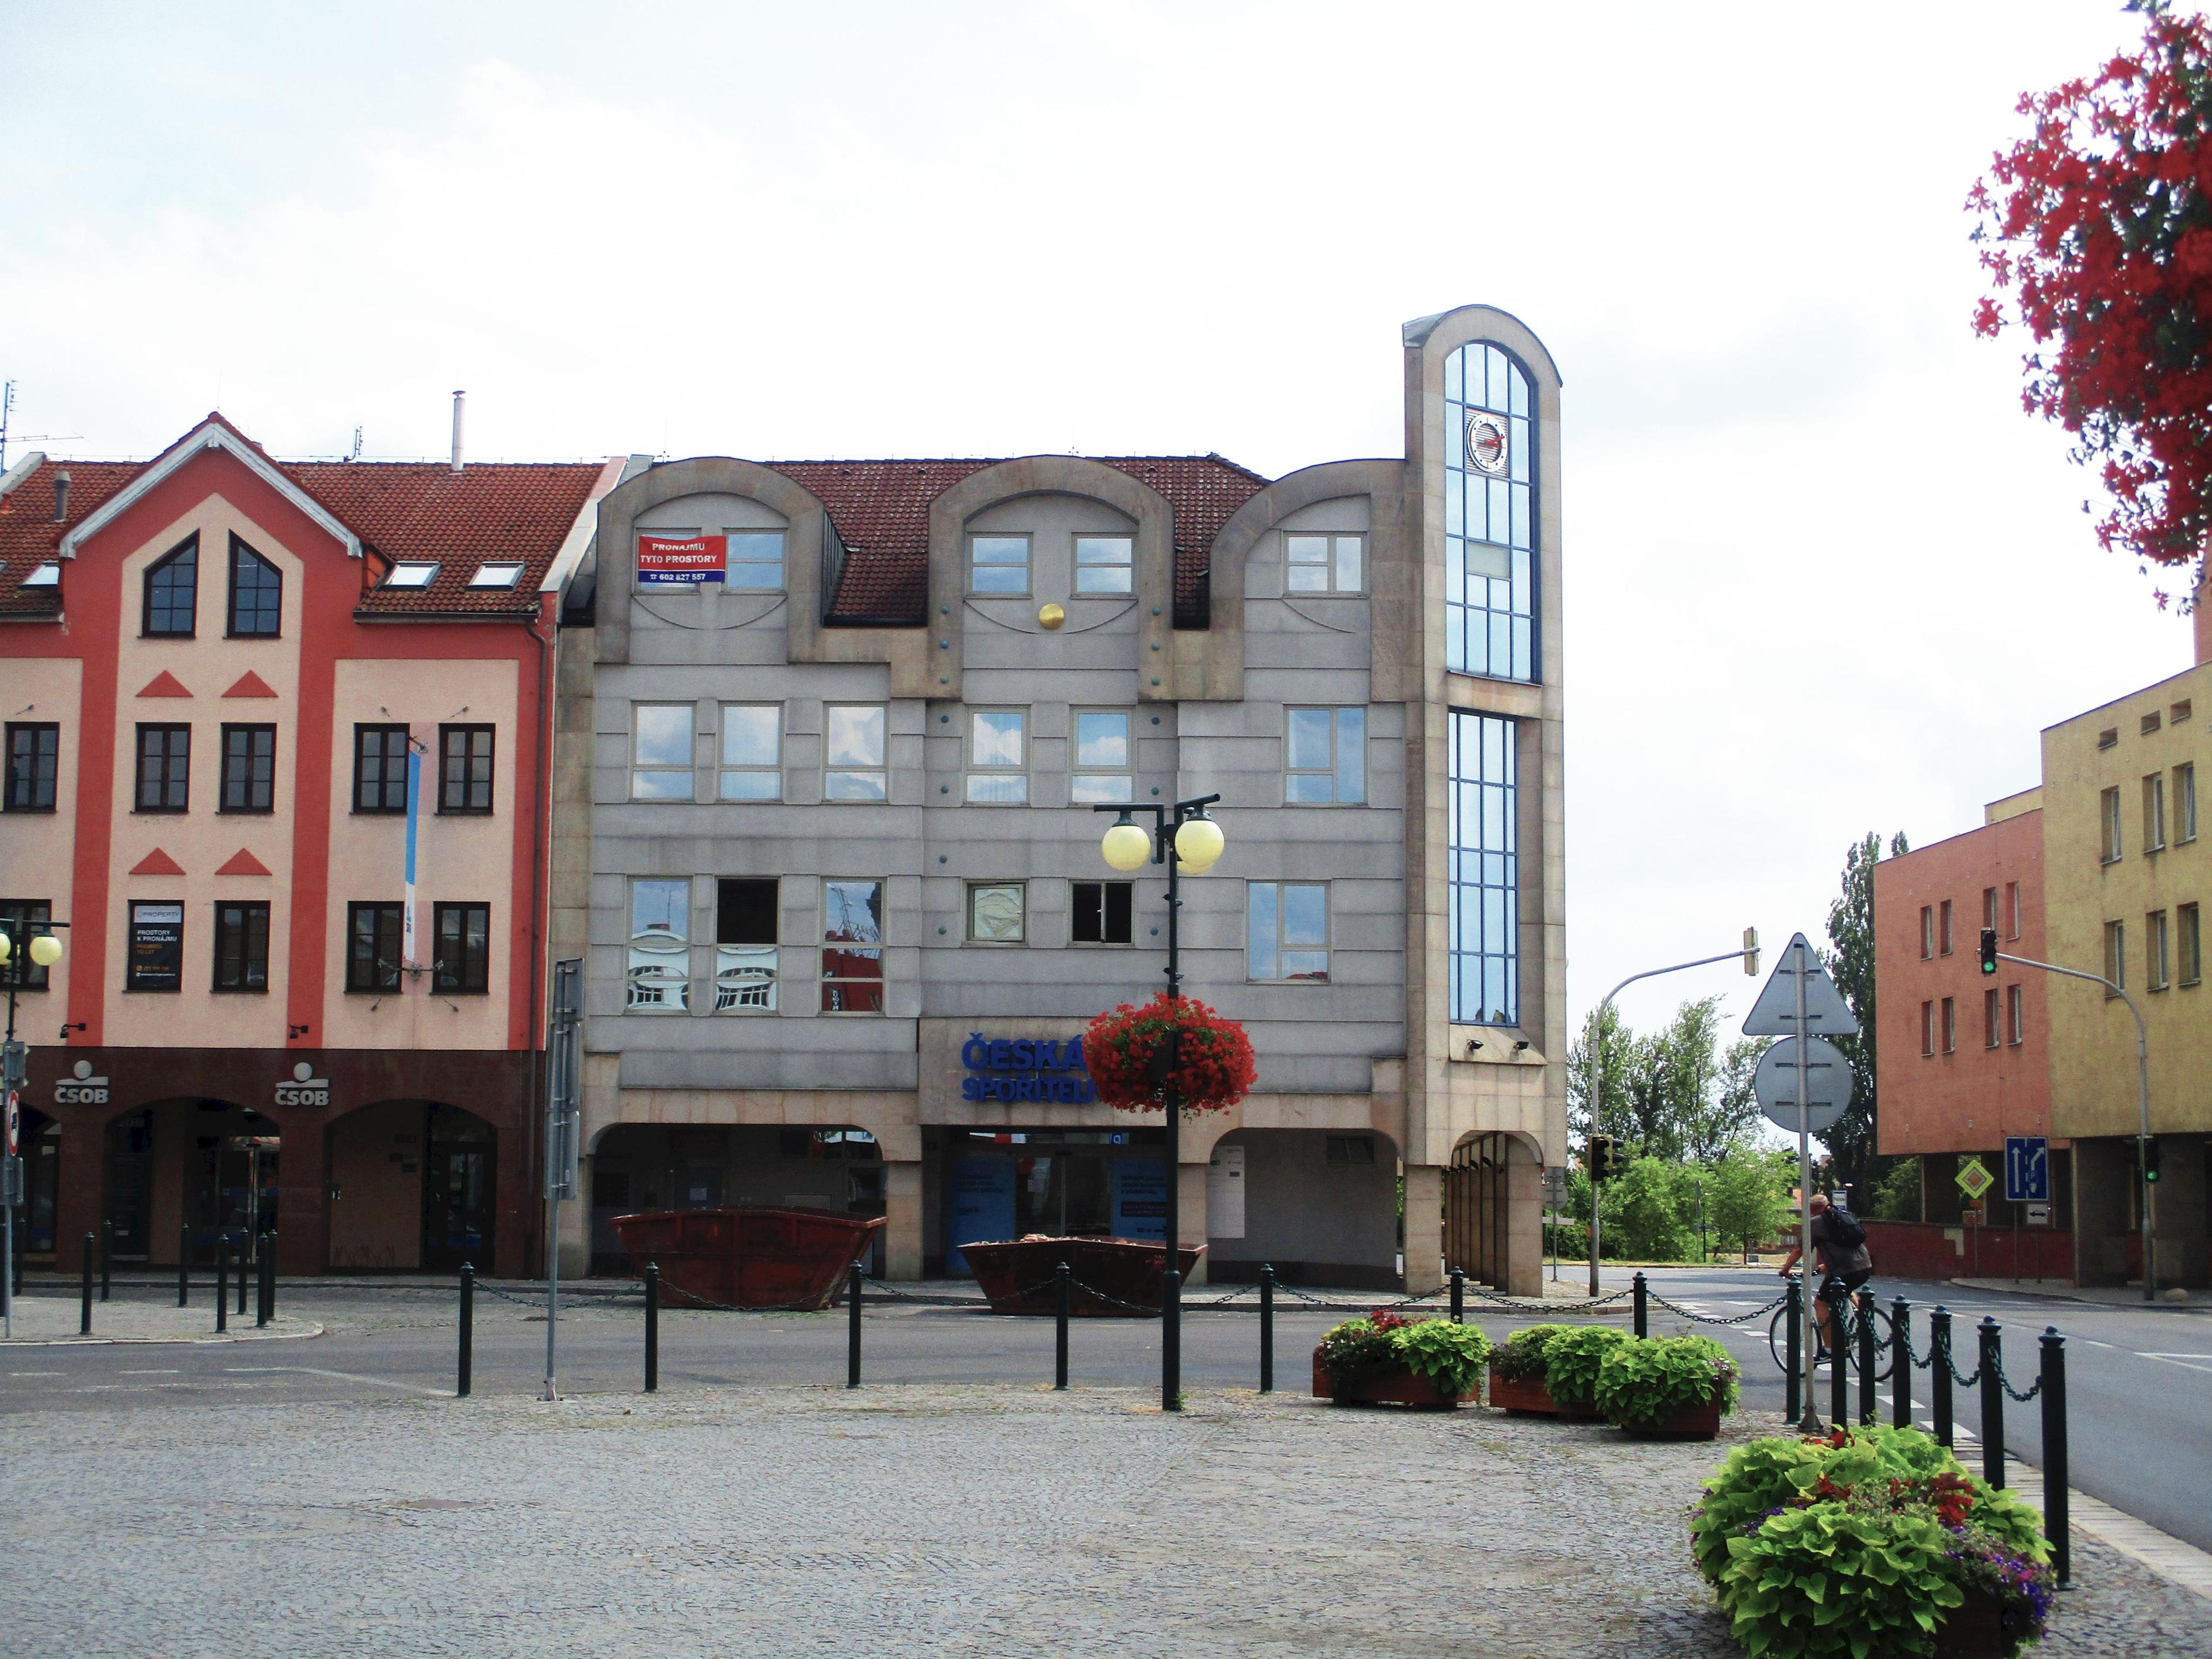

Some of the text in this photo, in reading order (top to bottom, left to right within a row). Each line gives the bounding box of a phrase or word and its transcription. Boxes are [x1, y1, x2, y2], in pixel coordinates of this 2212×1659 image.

[652, 542, 705, 551] PRONAJMU
[962, 1032, 1089, 1072] ČESKÁ
[54, 1086, 109, 1104] ČSOB
[275, 1088, 330, 1106] ČSOB
